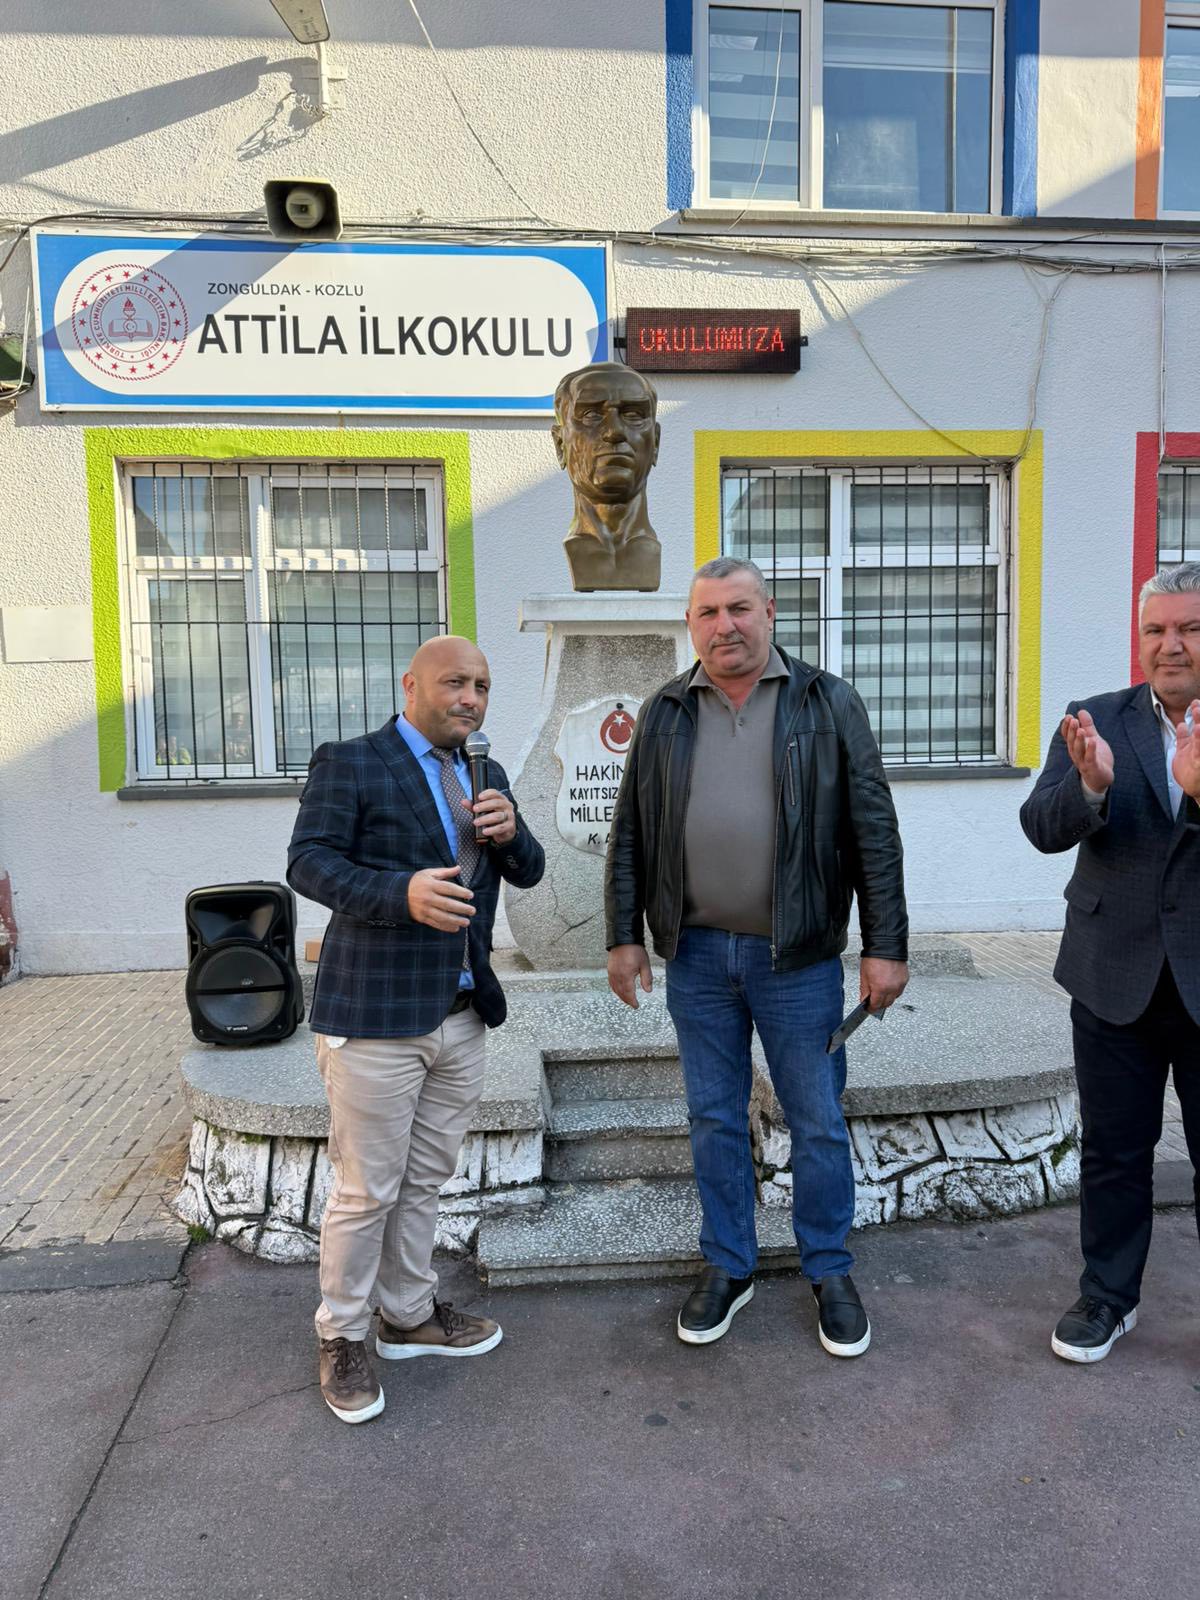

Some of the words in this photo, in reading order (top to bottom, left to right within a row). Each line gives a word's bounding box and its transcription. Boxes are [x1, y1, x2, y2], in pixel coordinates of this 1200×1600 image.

[207, 282, 302, 296] ZONGULDAK
[315, 284, 364, 297] KOZLU
[197, 304, 348, 355] ATTİLA
[360, 305, 572, 357] İLKOKULU
[569, 787, 619, 801] KAYITSIZ
[570, 803, 615, 823] MİLLE
[587, 833, 601, 845] K.
